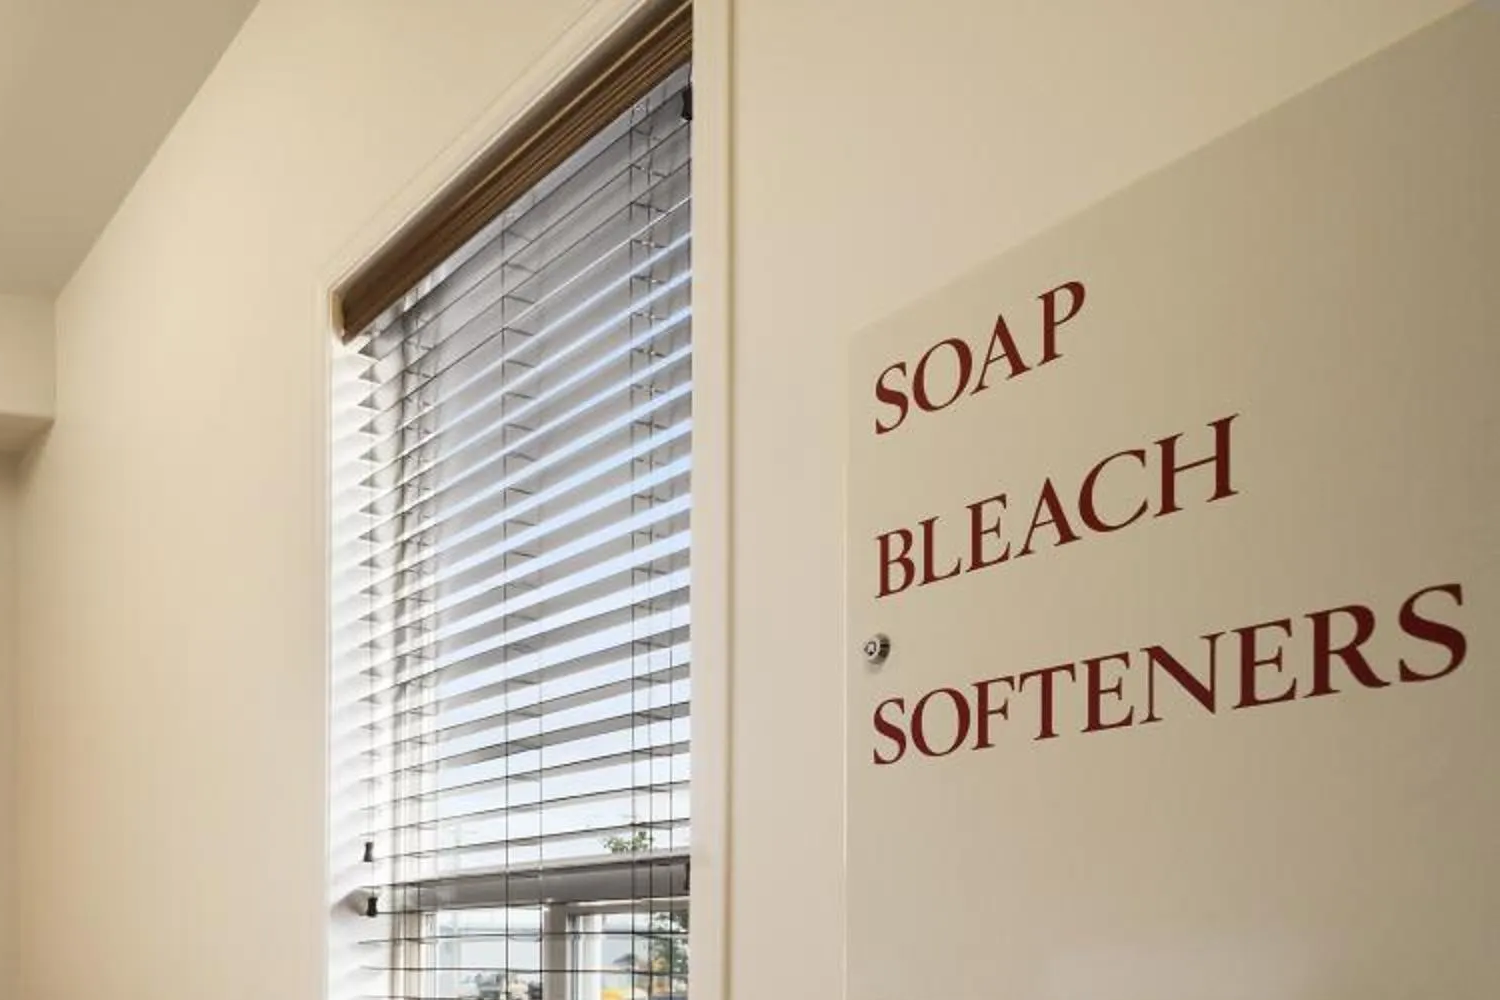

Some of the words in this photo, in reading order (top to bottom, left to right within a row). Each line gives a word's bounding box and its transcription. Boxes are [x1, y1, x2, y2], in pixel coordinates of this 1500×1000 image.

[875, 280, 1086, 435] SOAP
[874, 413, 1240, 599] BLEACH
[873, 583, 1468, 765] SOFTENERS
